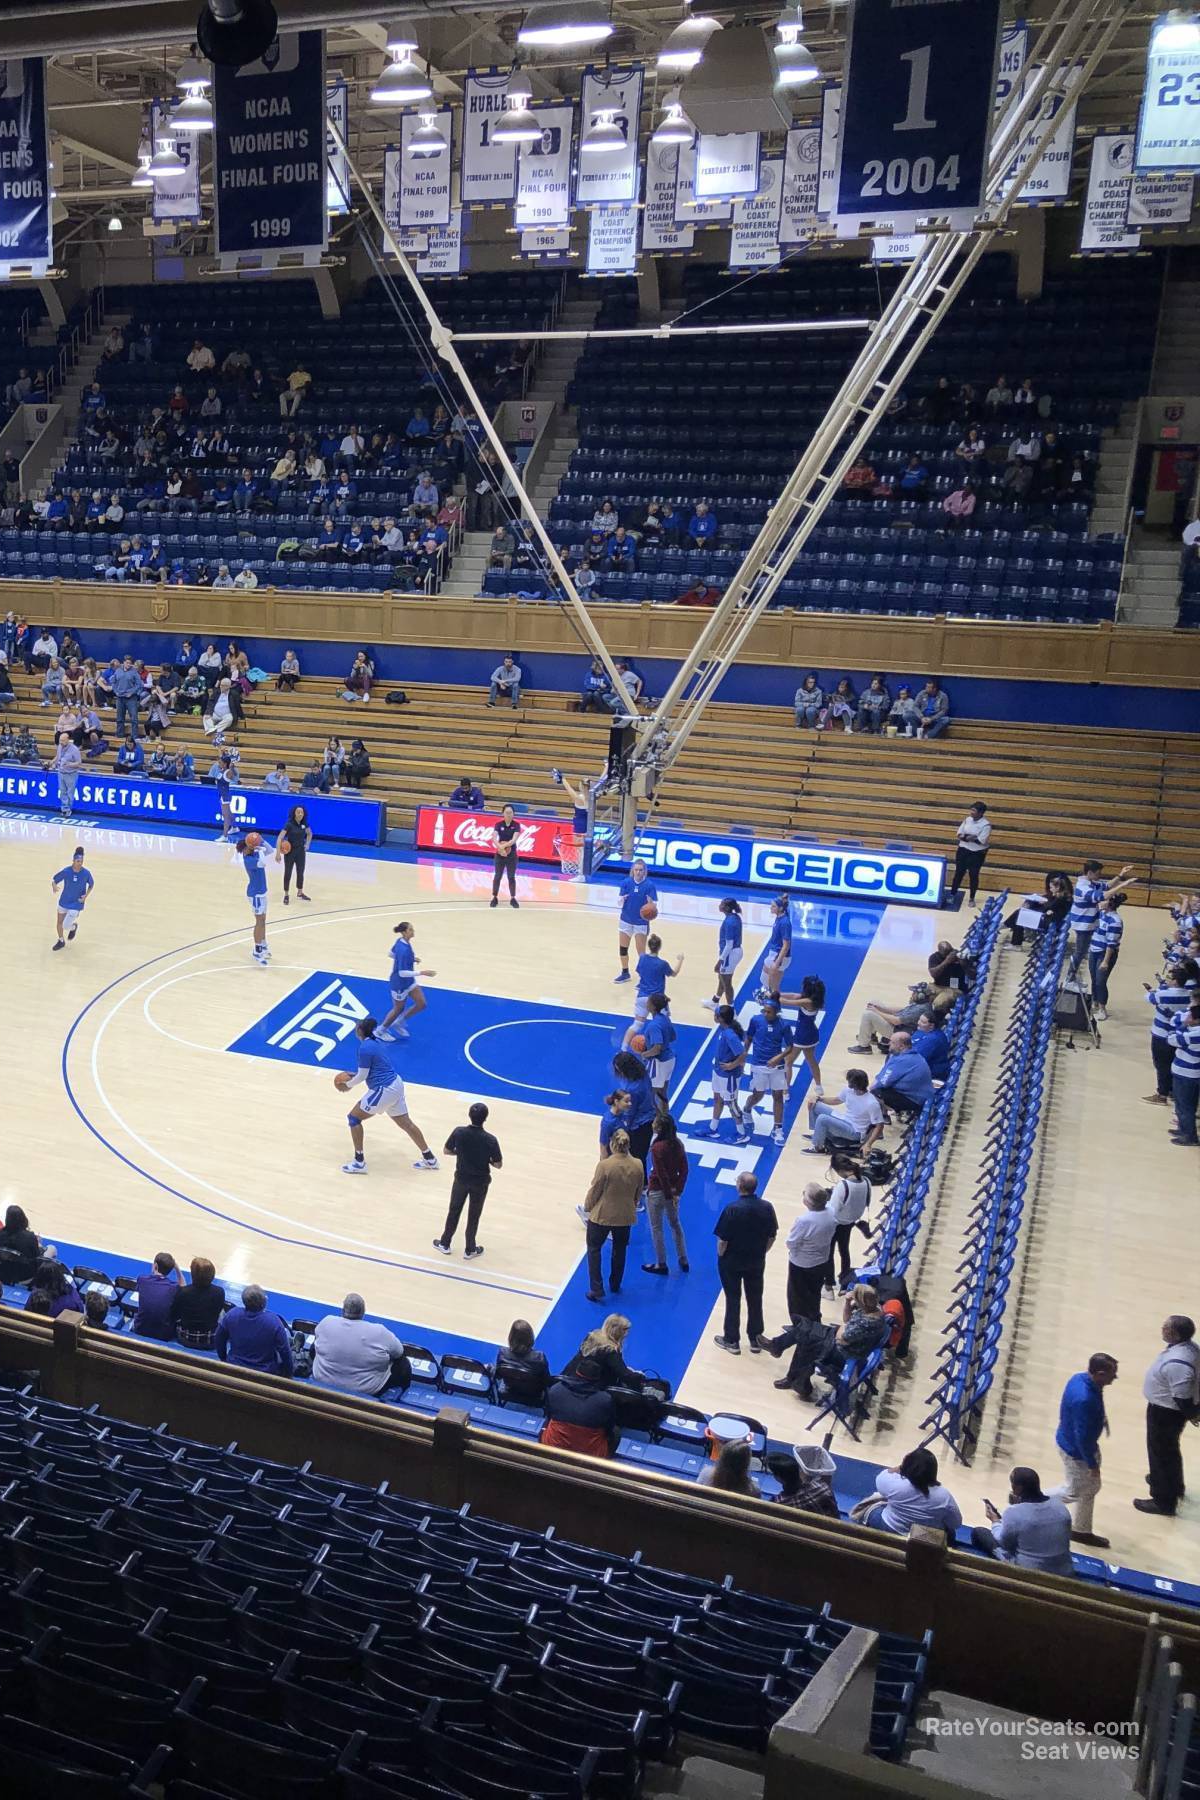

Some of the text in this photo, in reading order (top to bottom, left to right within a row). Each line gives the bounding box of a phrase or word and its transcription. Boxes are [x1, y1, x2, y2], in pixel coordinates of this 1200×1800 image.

[893, 45, 936, 131] 1
[1157, 73, 1200, 106] 23
[245, 97, 291, 119] NCAA
[230, 128, 309, 154] WOMEN'S
[1042, 151, 1070, 162] FOUR
[221, 162, 319, 188] FINAL FOUR
[415, 172, 436, 181] NCAA
[532, 168, 554, 178] NCAA
[860, 154, 960, 197] 2004
[3, 180, 43, 200] FOUR
[402, 187, 424, 196] FINAL
[427, 185, 448, 194] FOUR
[520, 183, 567, 193] FINAL FOUR
[798, 183, 818, 193] COAS
[1135, 184, 1190, 195] CHAMPIONS
[742, 201, 776, 210] ATLANTIC
[415, 210, 434, 218] 1989
[532, 207, 552, 217] 1990
[747, 212, 770, 220] COAST
[602, 218, 625, 227] COAST
[250, 218, 291, 238] 1999
[593, 227, 635, 237] CONFERENCE
[735, 230, 779, 240] CHAMPIONS
[536, 236, 555, 246] 1965
[594, 237, 633, 246] CHAMPIONS
[888, 243, 910, 253] 2005
[745, 252, 766, 260] 2004
[429, 260, 447, 268] 2002
[523, 410, 533, 420] 14
[154, 604, 166, 616] 17
[755, 849, 929, 896] GEICO
[279, 985, 371, 1062] ACC
